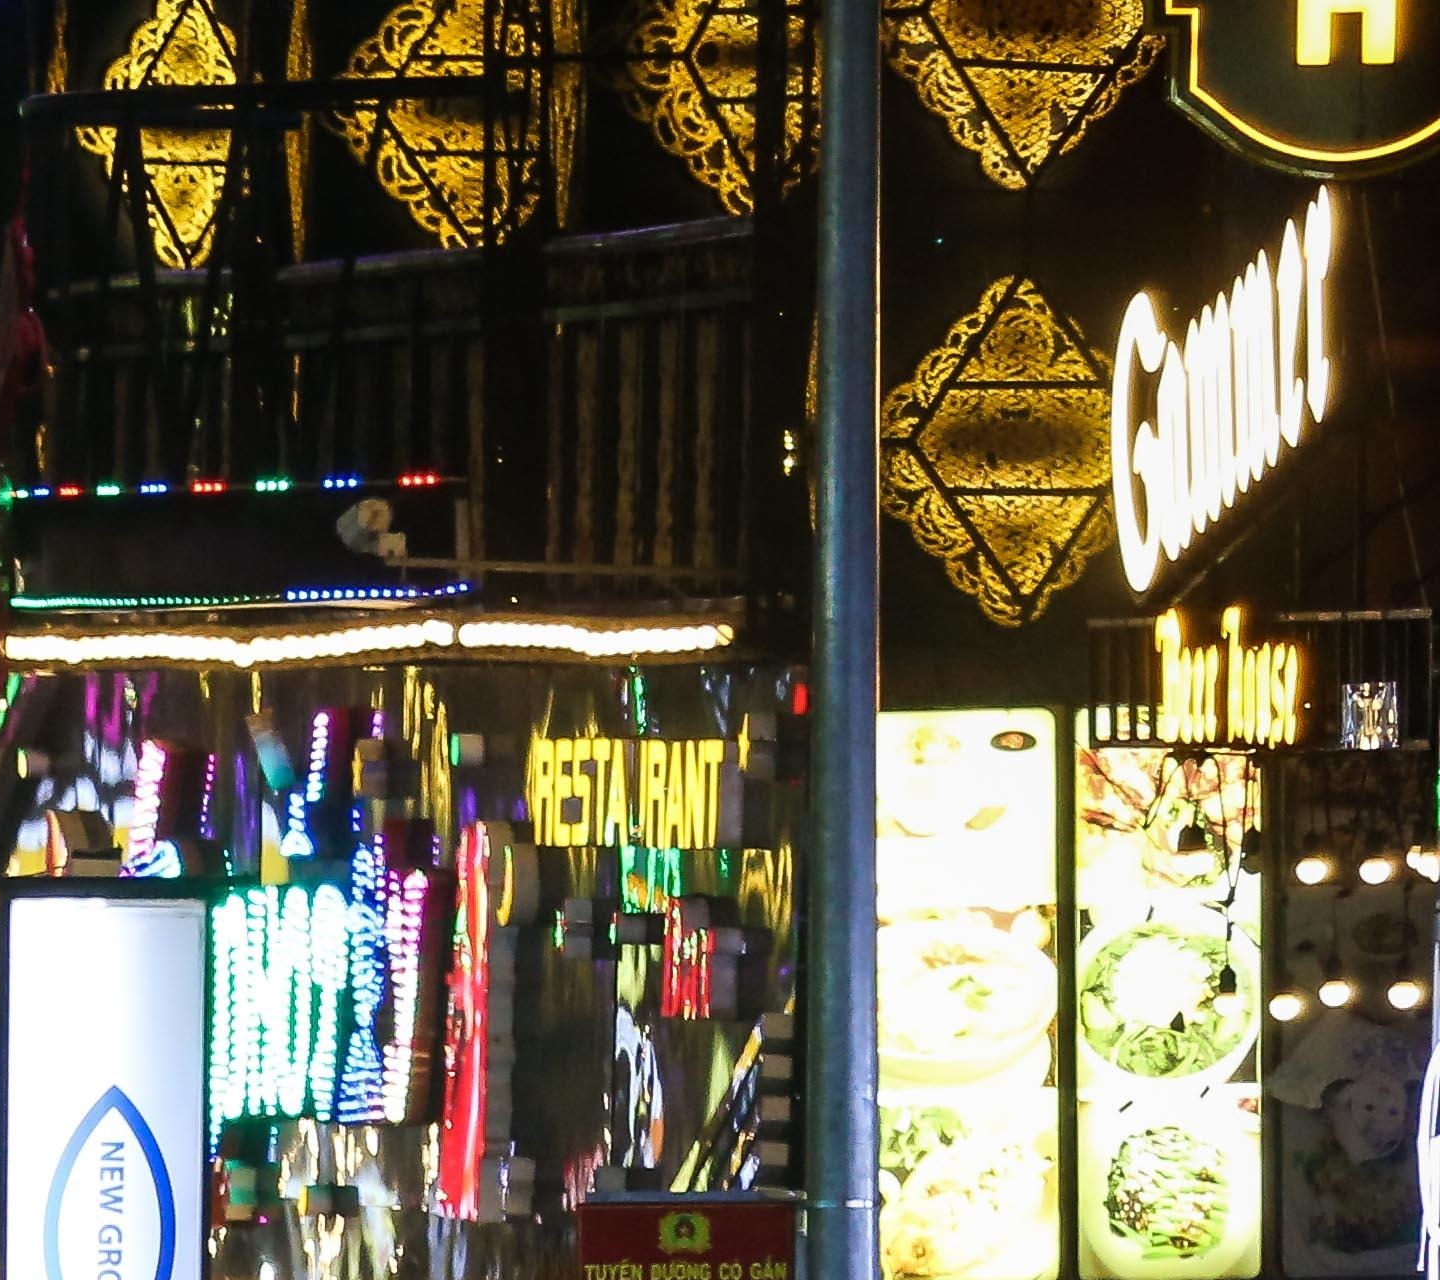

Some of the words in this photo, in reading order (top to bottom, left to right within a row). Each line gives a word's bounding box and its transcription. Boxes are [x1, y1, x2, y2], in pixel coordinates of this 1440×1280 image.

[1111, 184, 1332, 592] Gammer
[1154, 606, 1220, 746] Beer
[98, 1141, 126, 1215] NEW
